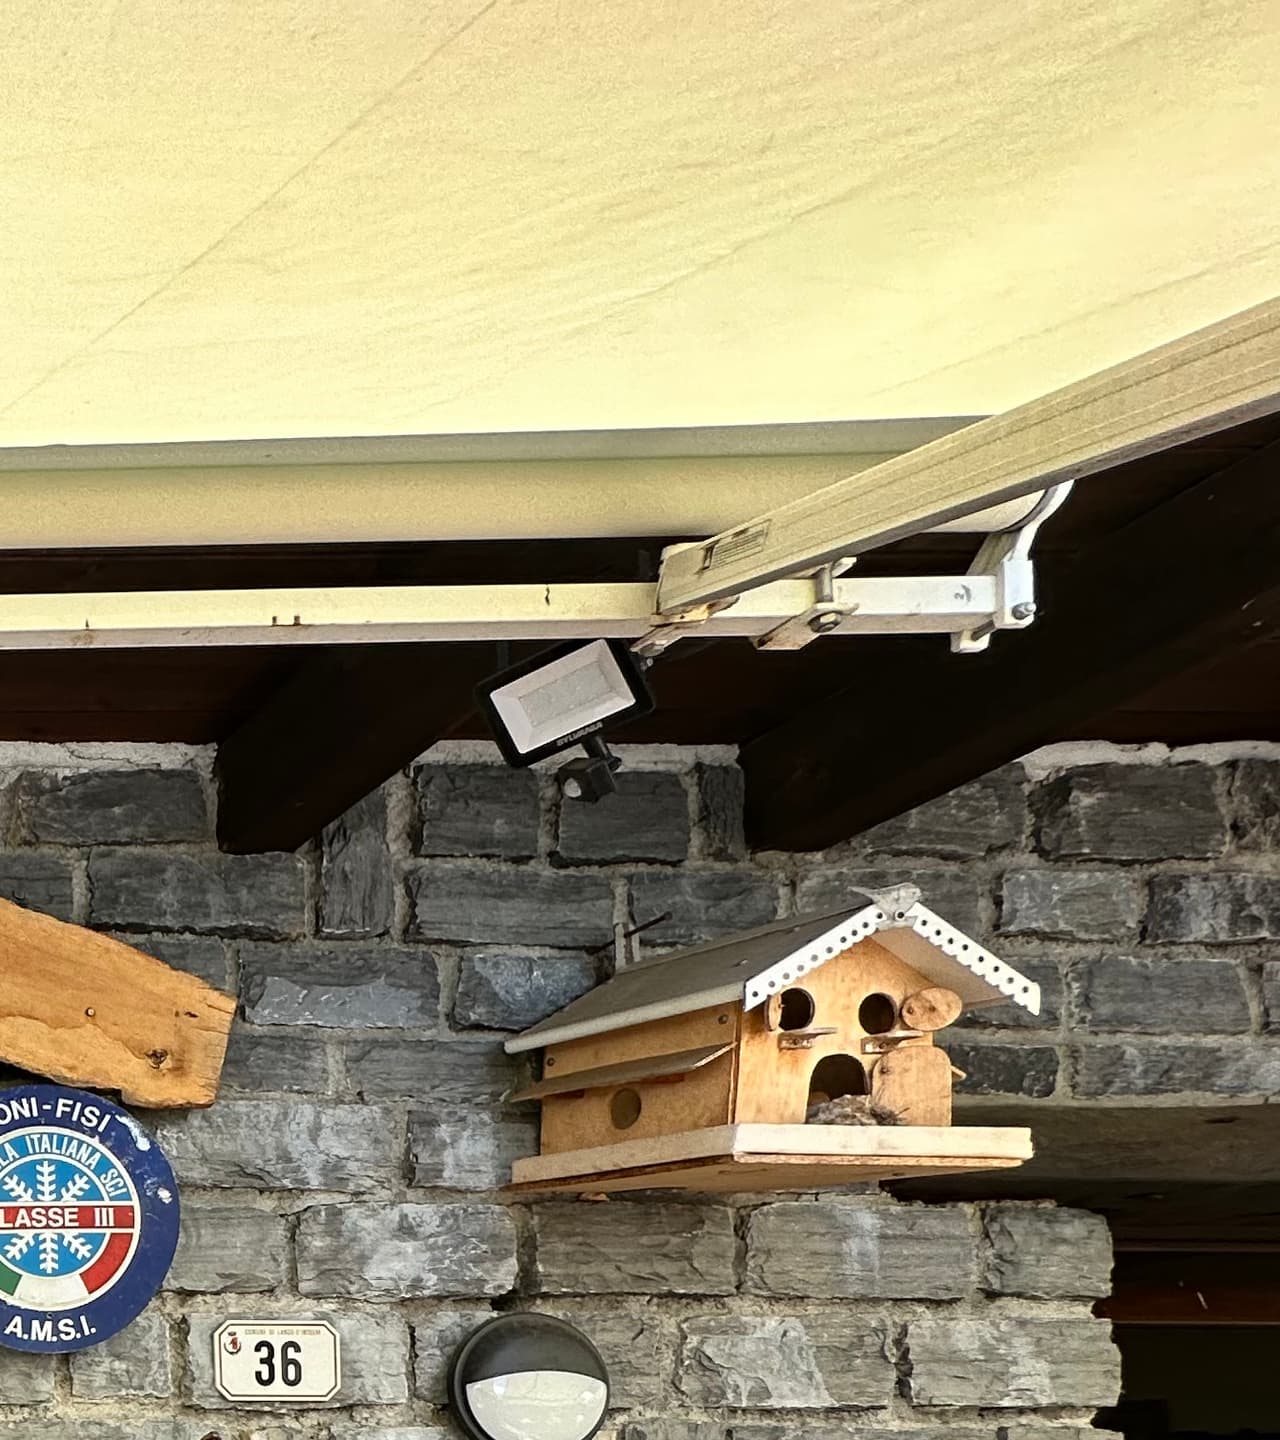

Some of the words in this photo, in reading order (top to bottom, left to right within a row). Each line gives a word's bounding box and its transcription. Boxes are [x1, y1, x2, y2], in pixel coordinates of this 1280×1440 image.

[25, 1134, 101, 1170] ITALIANA
[100, 1168, 127, 1197] SCI
[94, 1207, 115, 1227] III
[4, 1315, 96, 1342] A.M.S.I.
[253, 1340, 302, 1387] 36
